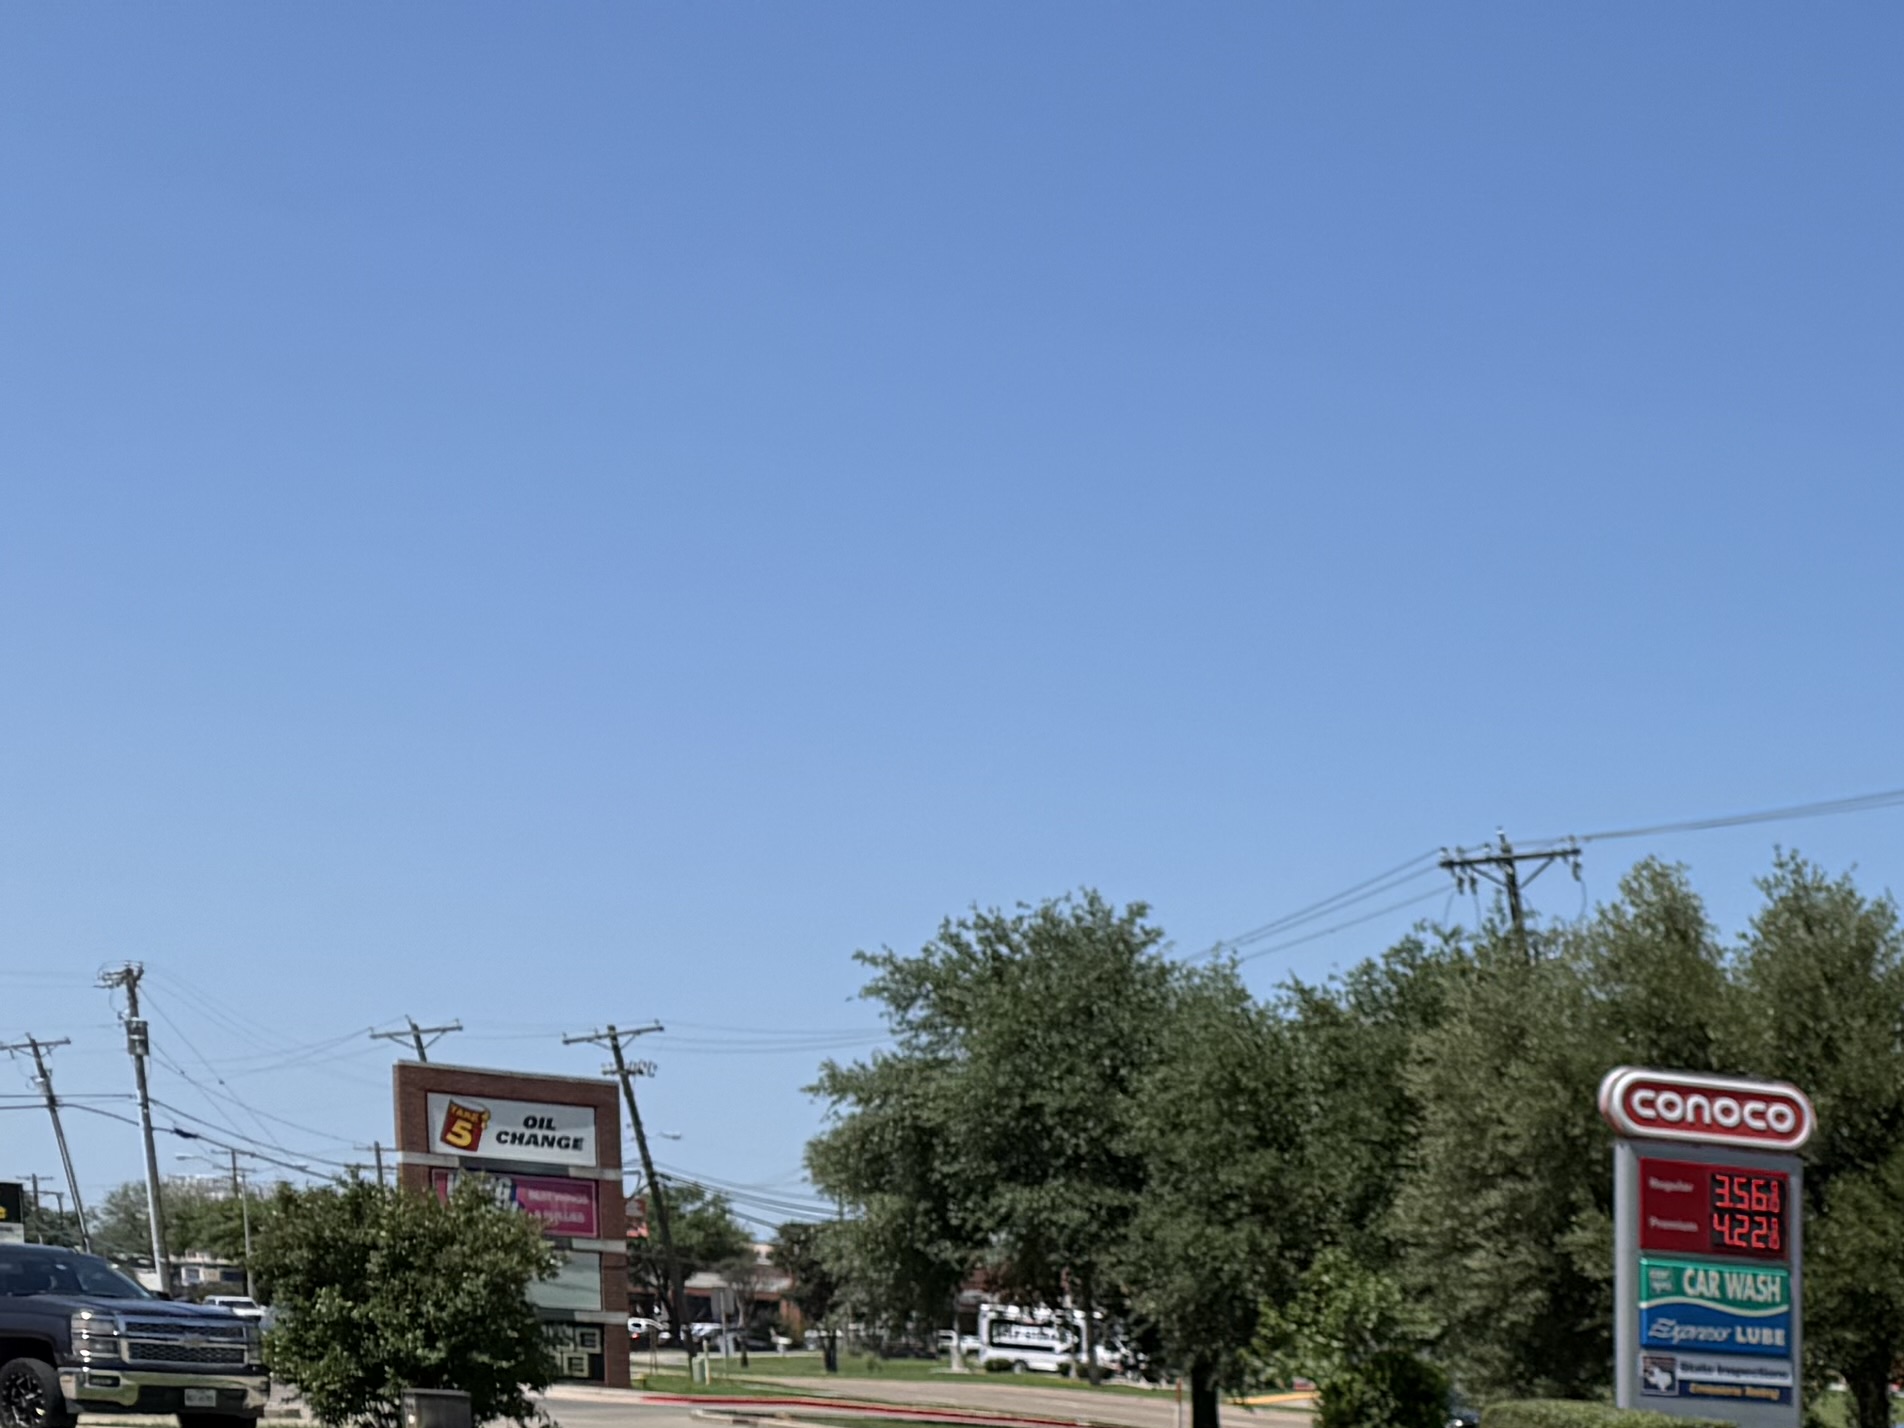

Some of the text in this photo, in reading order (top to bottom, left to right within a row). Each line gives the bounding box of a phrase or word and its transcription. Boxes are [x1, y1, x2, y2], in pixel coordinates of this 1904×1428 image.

[445, 1119, 474, 1149] 5
[522, 1114, 557, 1132] OIL
[495, 1130, 585, 1152] CHANGE
[1682, 1267, 1721, 1299] CAR
[1724, 1270, 1782, 1303] WASH
[1734, 1325, 1786, 1347] LUBE
